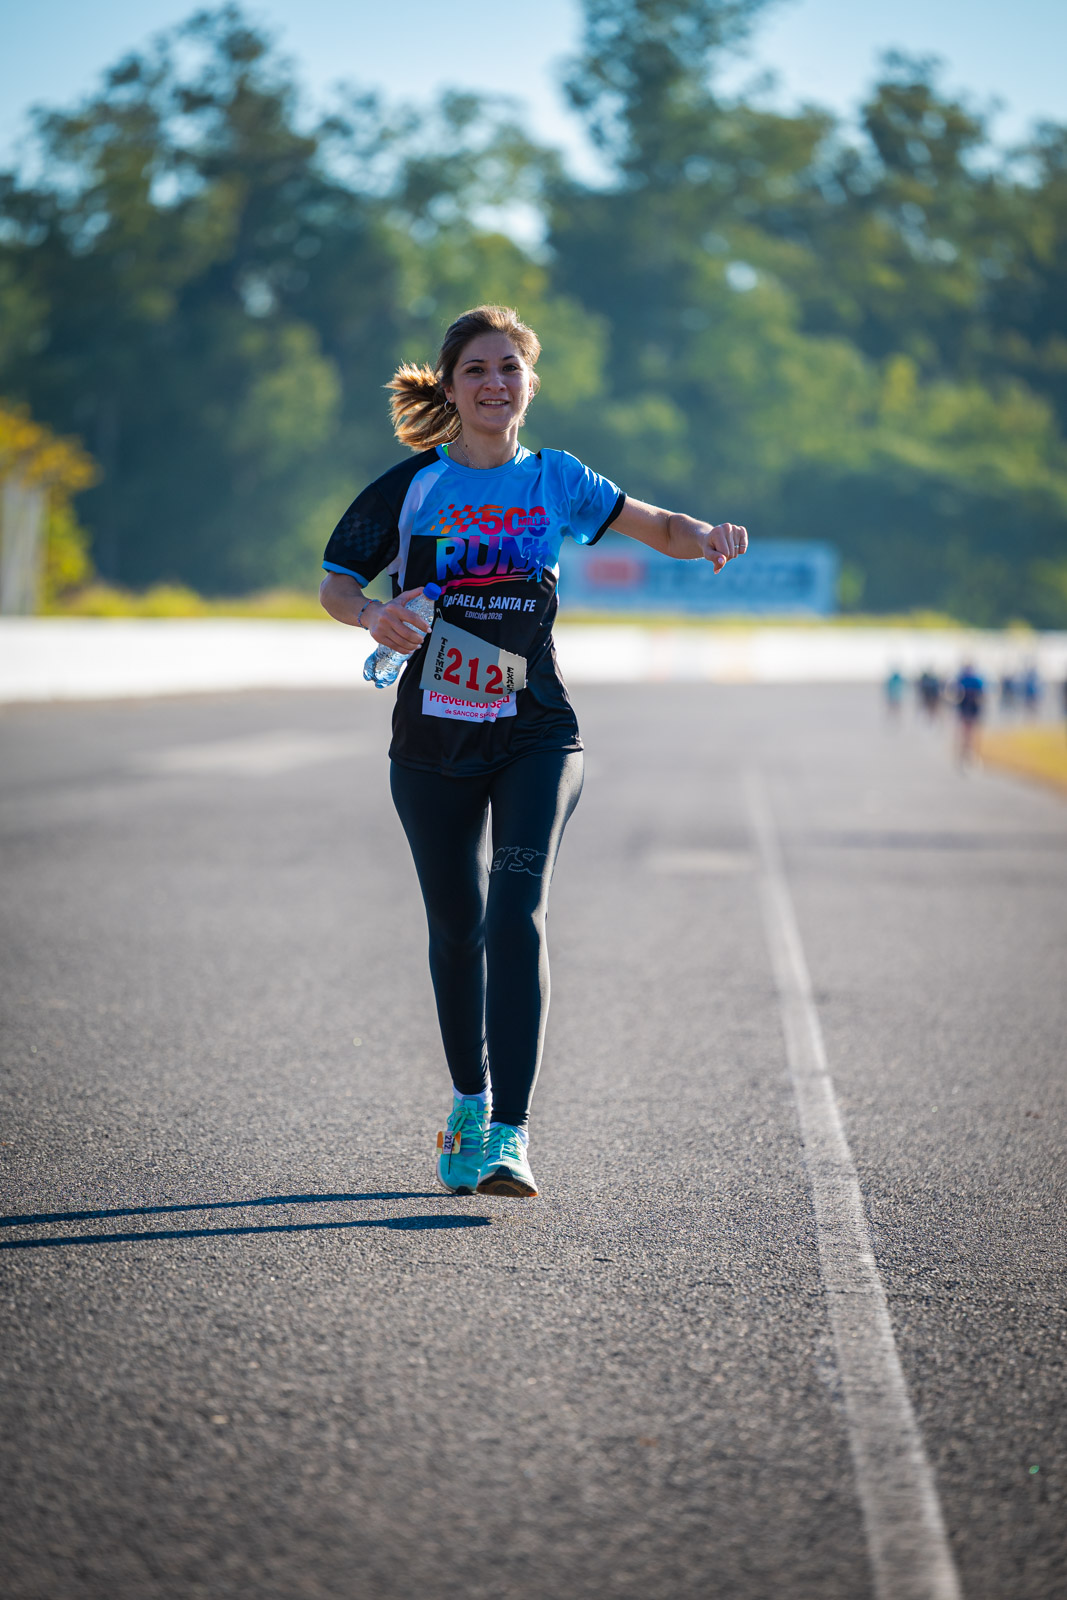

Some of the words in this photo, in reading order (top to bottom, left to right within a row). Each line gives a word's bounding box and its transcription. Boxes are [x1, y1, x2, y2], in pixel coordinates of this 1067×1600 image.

[518, 516, 550, 526] MILLAS
[436, 535, 534, 581] RUN
[488, 596, 522, 611] SANTA
[523, 599, 536, 612] FE
[488, 612, 503, 620] 2026
[434, 637, 448, 681] TIEMPO
[443, 647, 504, 695] 212
[452, 709, 479, 718] SANCOR
[444, 1135, 452, 1150] 212
